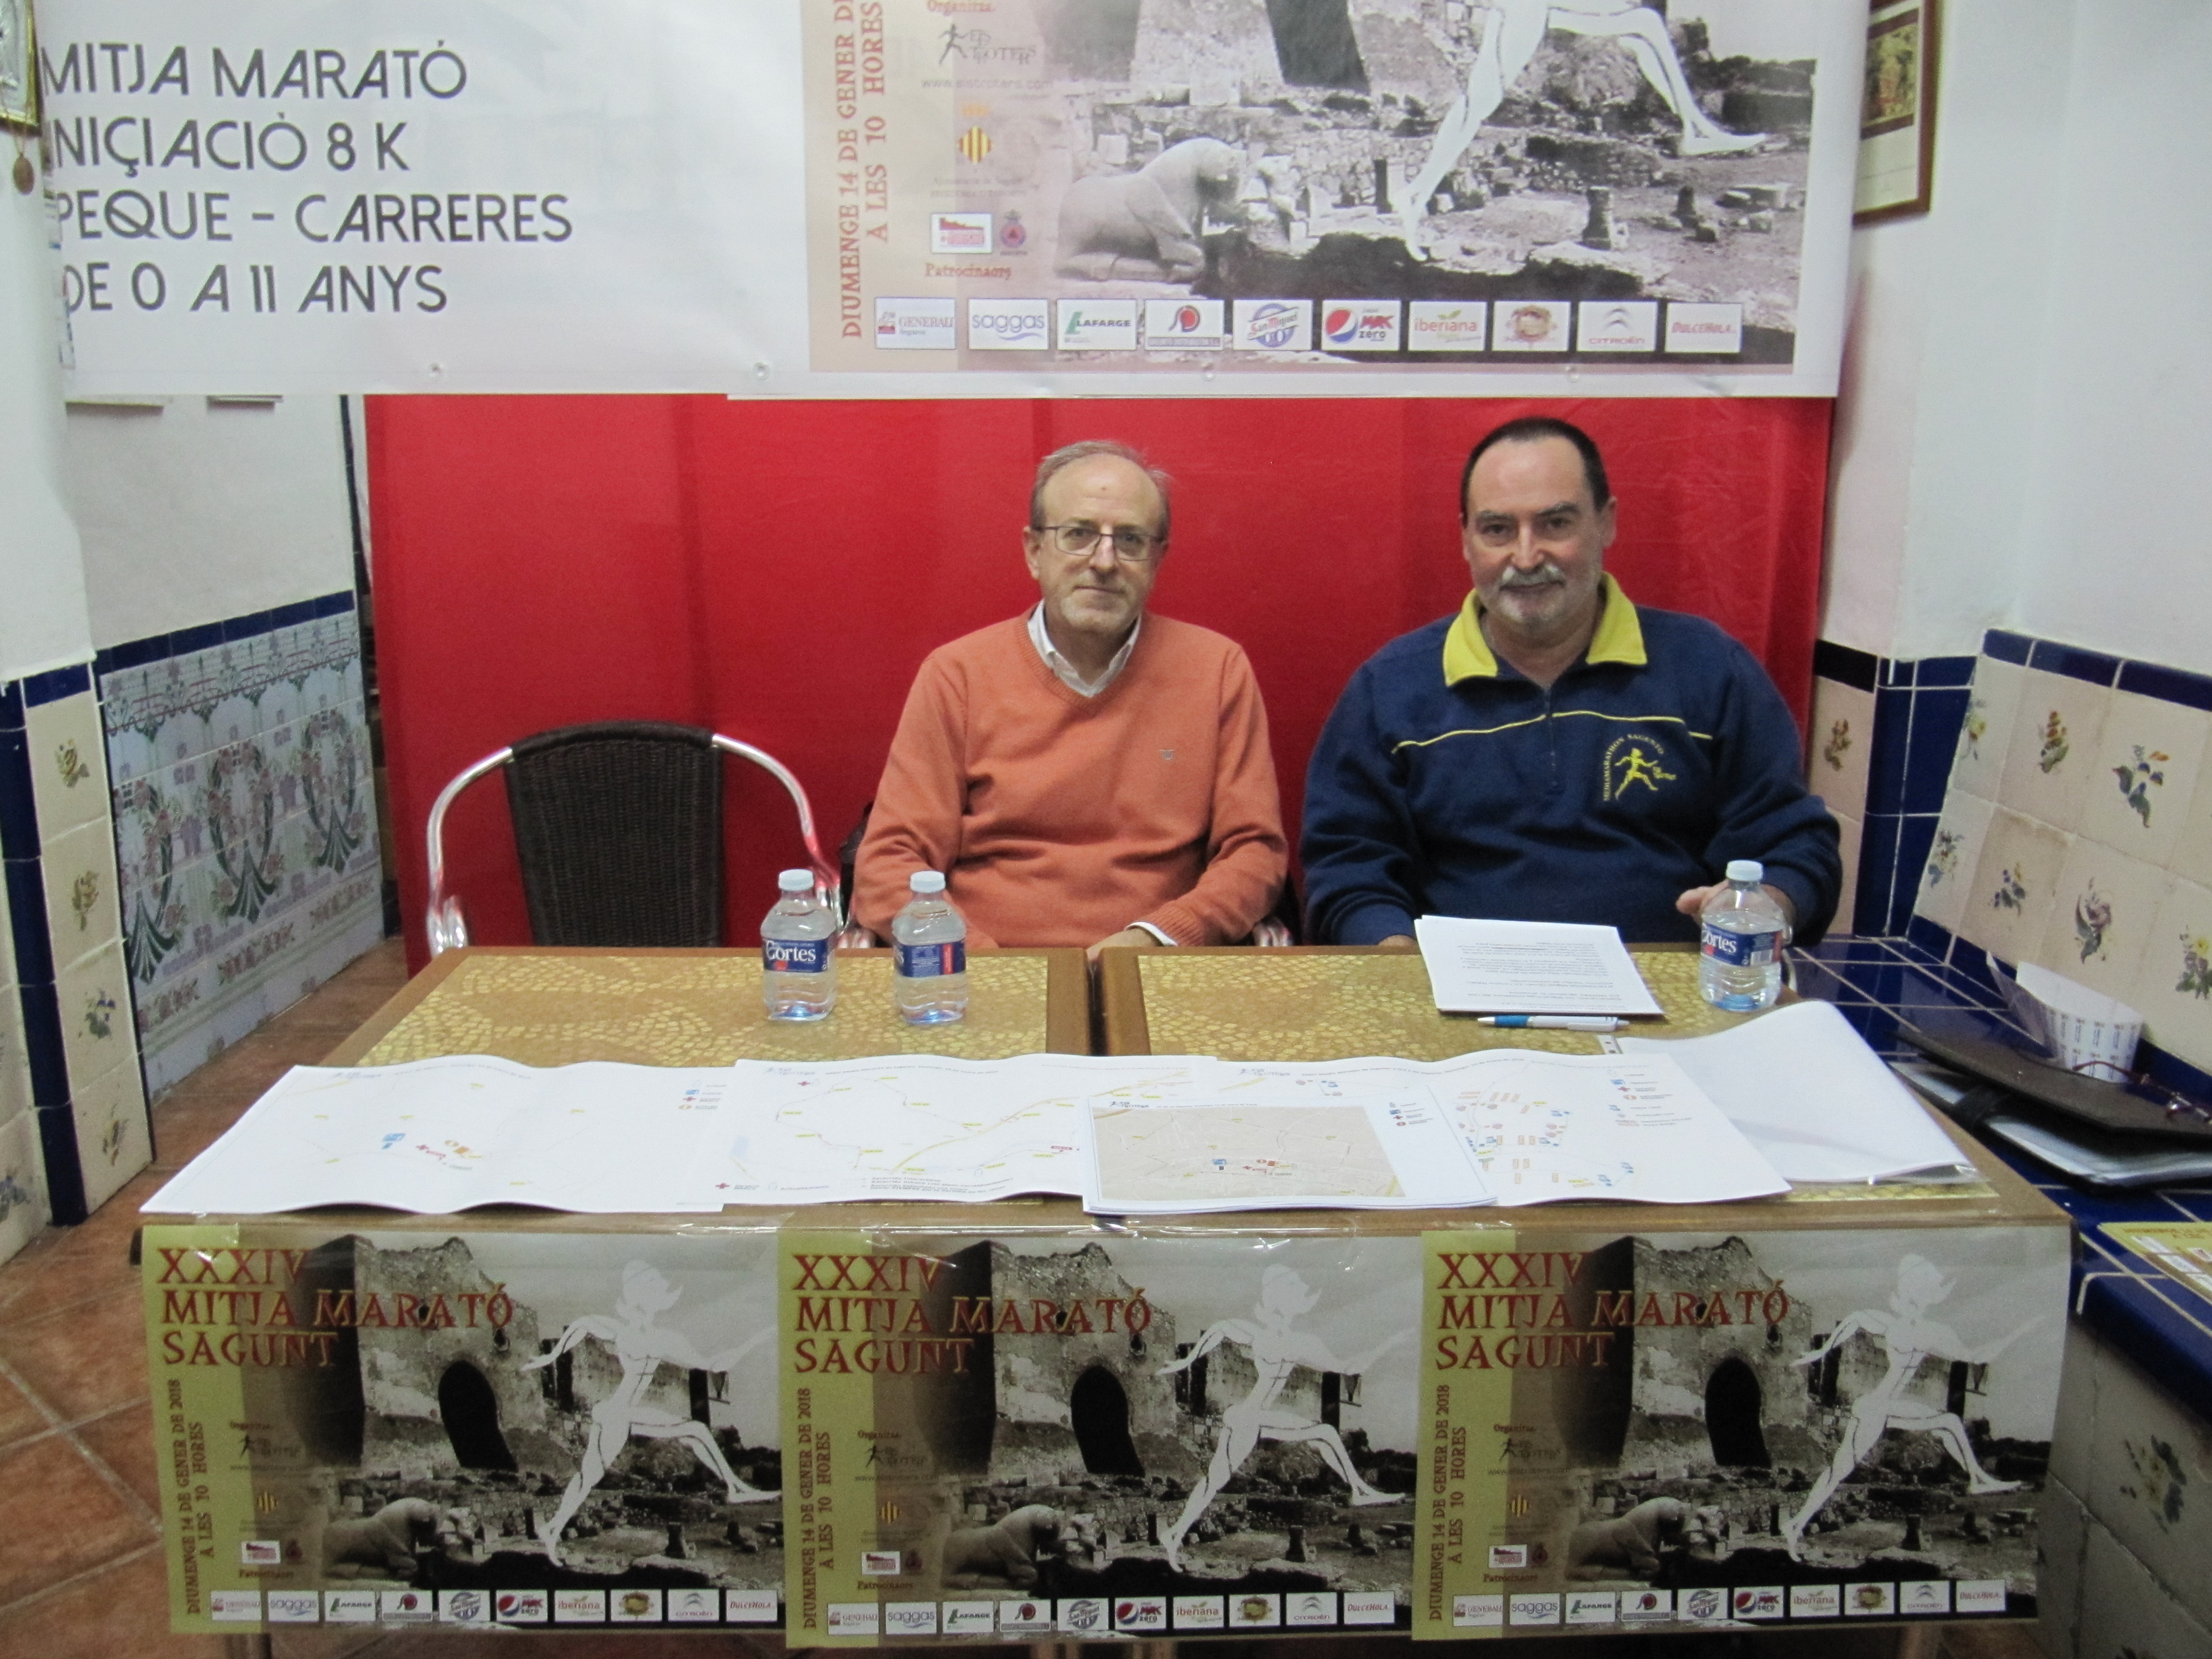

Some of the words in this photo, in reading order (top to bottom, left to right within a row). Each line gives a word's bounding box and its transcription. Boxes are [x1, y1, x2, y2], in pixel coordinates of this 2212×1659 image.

[860, 2, 885, 96] HORES
[41, 43, 190, 96] MITJA
[212, 39, 467, 100] MARATÓ
[836, 31, 857, 121] GENER
[327, 121, 356, 171] 8
[375, 121, 410, 171] K
[838, 128, 858, 163] DE
[864, 115, 886, 144] 10
[839, 172, 858, 197] 14
[865, 164, 889, 213] LES
[59, 190, 233, 241] PEQUE
[295, 193, 572, 243] CARRERES
[867, 222, 889, 244] A
[839, 205, 862, 339] DIUMENGE
[190, 264, 229, 313] A
[298, 264, 448, 314] ANYS
[972, 313, 1045, 334] saggas
[1075, 319, 1131, 327] LAFARGE
[1358, 328, 1386, 340] zero
[1413, 318, 1477, 332] iberiana
[157, 1248, 312, 1284] XXXIV
[792, 1255, 947, 1292] XXXIV
[1437, 1253, 1590, 1289] XXXIV
[161, 1290, 297, 1327] MITJA
[312, 1281, 514, 1328] MARATÓ
[795, 1296, 932, 1333] MITJA
[948, 1287, 1152, 1334] MARATÓ
[1438, 1294, 1574, 1329] MITJA
[1590, 1279, 1789, 1327] MARATÓ
[163, 1331, 338, 1368] SAGUNT
[793, 1337, 974, 1374] SAGUNT
[1435, 1332, 1615, 1370] SAGUNT
[797, 1388, 812, 1419] 2018
[1436, 1384, 1450, 1416] 2018
[798, 1425, 812, 1444] DE
[1436, 1420, 1449, 1439] DE
[173, 1440, 191, 1488] GENER
[189, 1422, 208, 1474] HORES
[816, 1432, 832, 1485] HORES
[1451, 1426, 1467, 1480] HORES
[800, 1449, 814, 1499] GENER
[1433, 1446, 1448, 1494] GENER
[801, 1504, 815, 1524] DE
[817, 1496, 832, 1512] 10
[1433, 1499, 1446, 1519] DE
[1450, 1491, 1464, 1507] 10
[802, 1529, 815, 1544] 14
[818, 1523, 834, 1553] LES
[1432, 1523, 1445, 1538] 14
[1448, 1518, 1463, 1548] LES
[819, 1558, 834, 1569] A
[1448, 1553, 1463, 1564] A
[803, 1548, 817, 1630] DIUMENGE
[1430, 1542, 1445, 1621] DIUMENGE
[558, 1600, 601, 1610] iberiana
[1176, 1606, 1219, 1616] iberiana
[1512, 1601, 1558, 1615] saggas
[1793, 1595, 1835, 1605] iberiana
[888, 1611, 935, 1625] saggas
